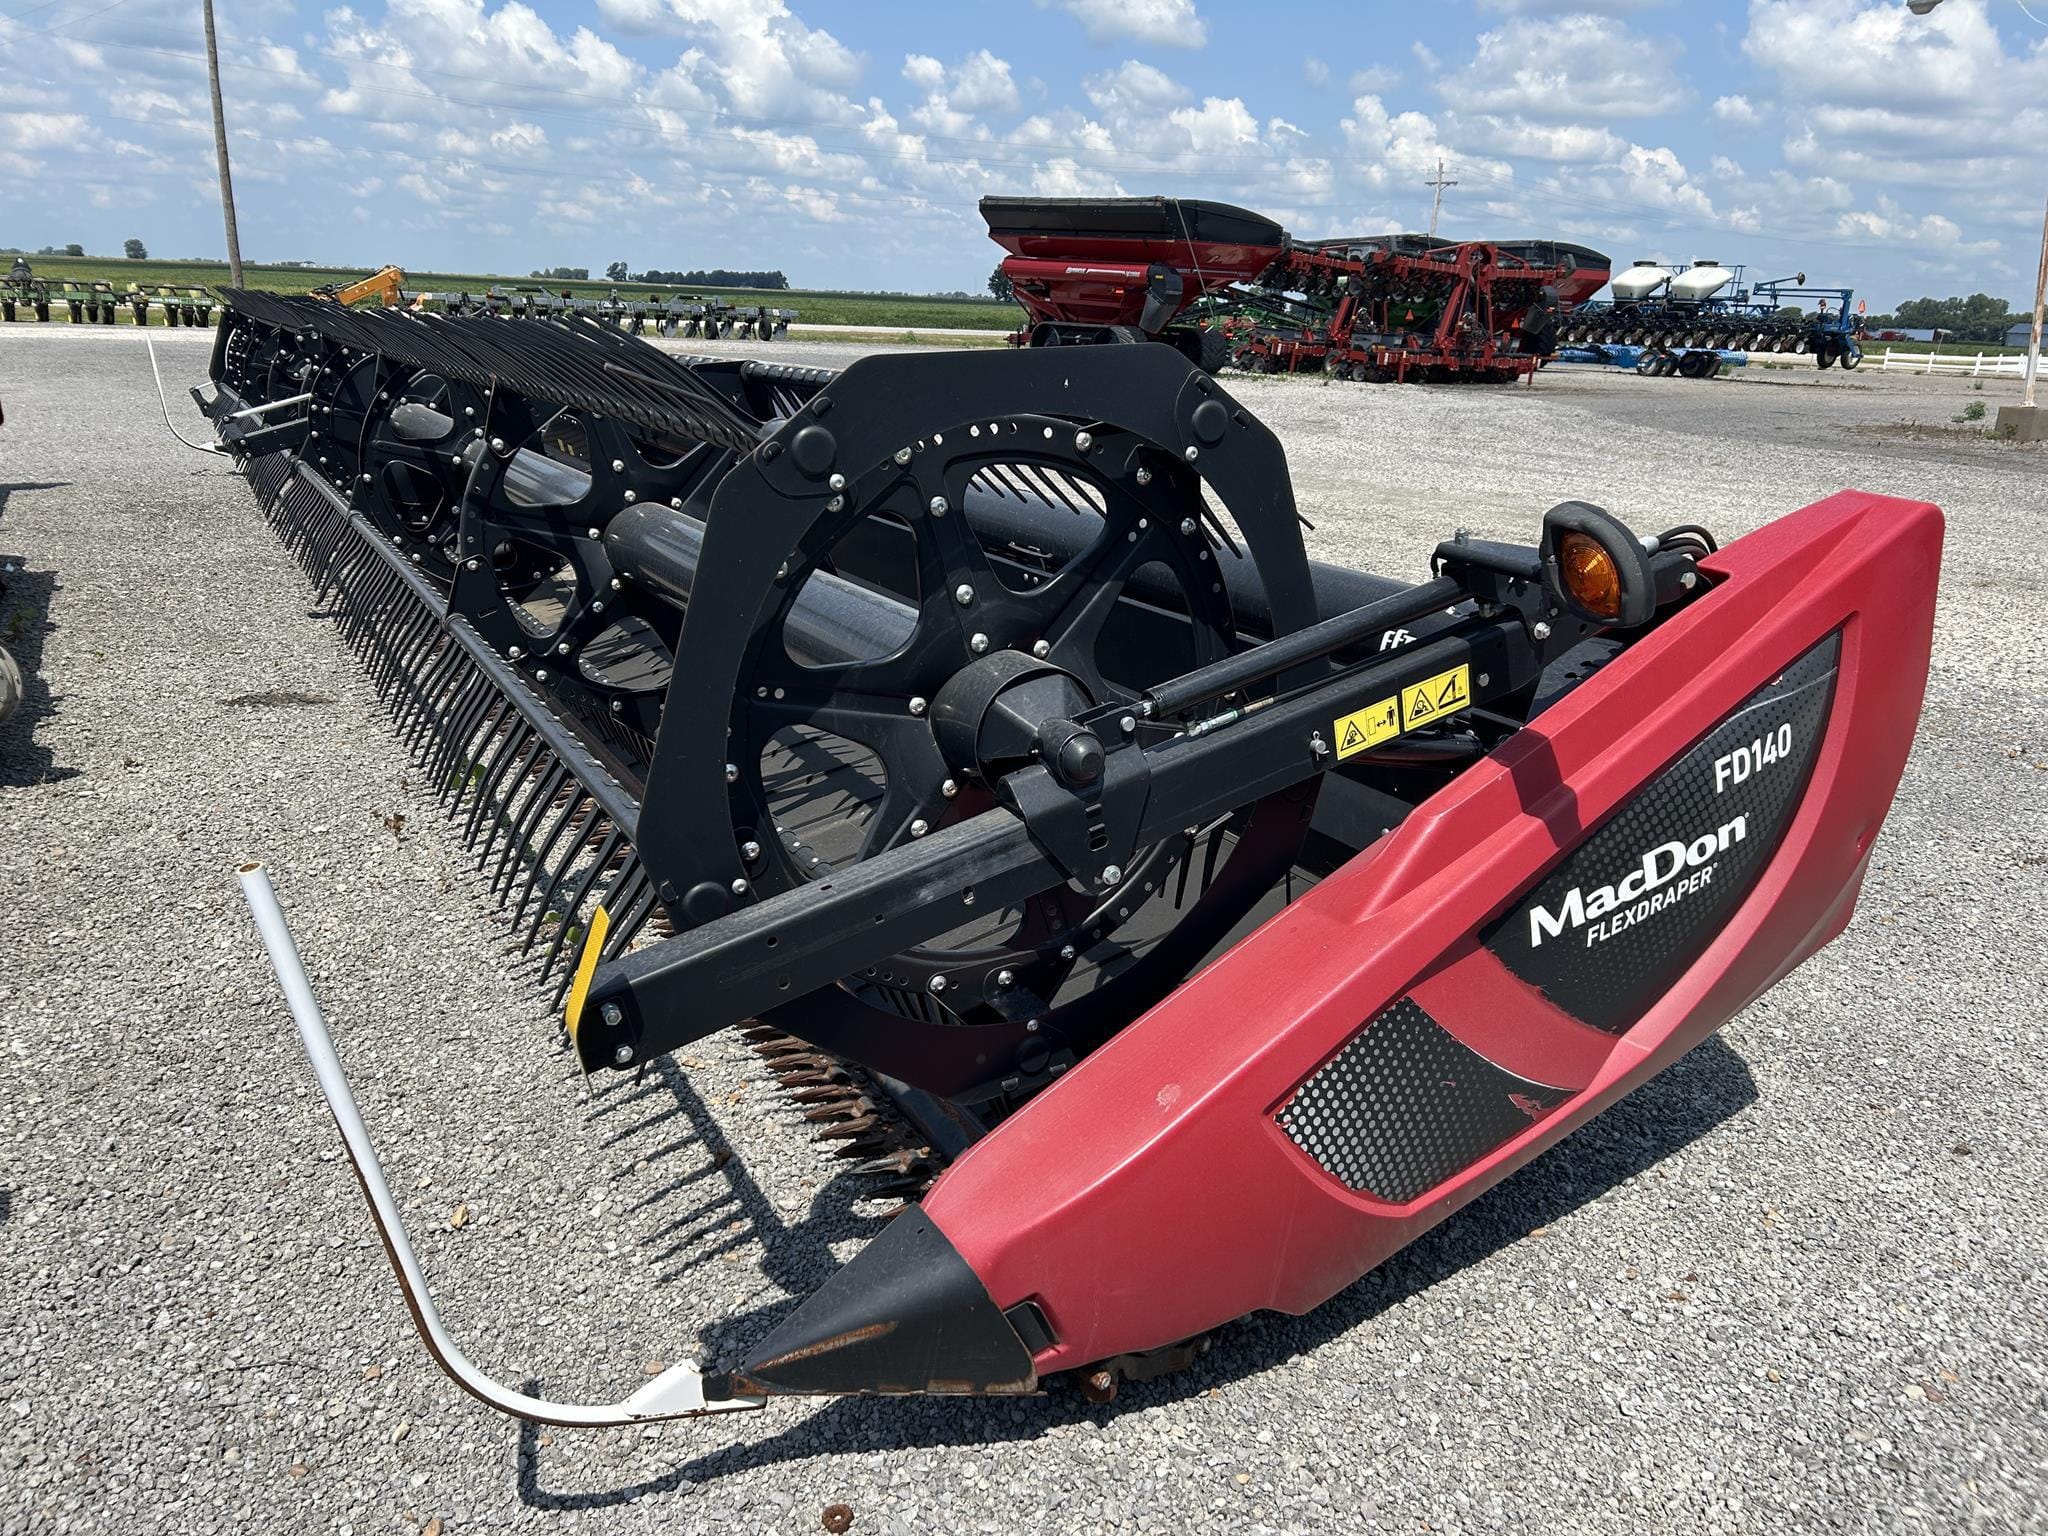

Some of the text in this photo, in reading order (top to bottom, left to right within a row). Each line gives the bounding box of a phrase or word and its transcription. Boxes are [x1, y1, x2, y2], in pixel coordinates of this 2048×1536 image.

[1714, 722, 1792, 794] FD140
[1530, 815, 1747, 948] MacDon
[1586, 865, 1714, 948] FLEXDRAPER
